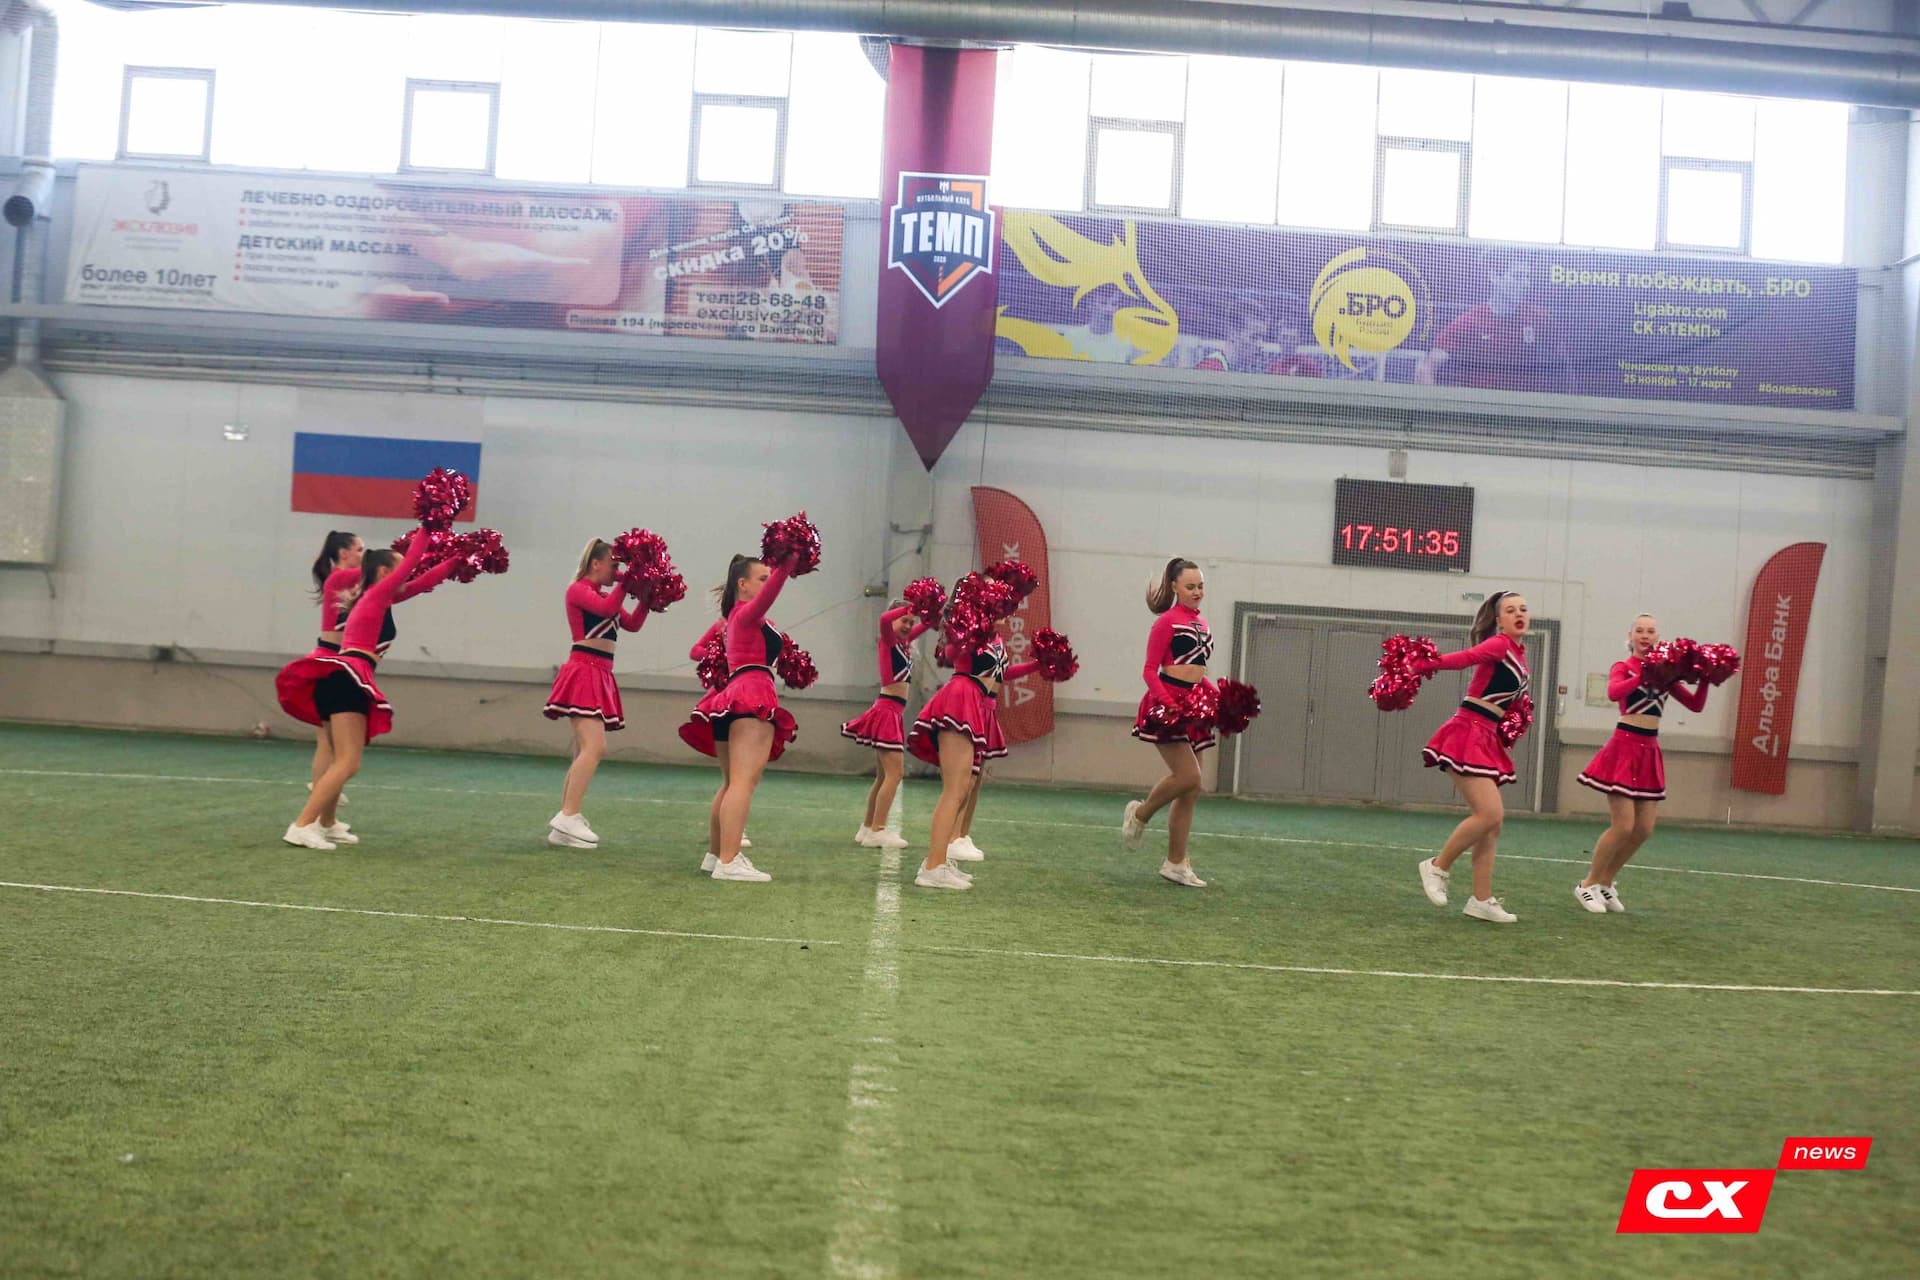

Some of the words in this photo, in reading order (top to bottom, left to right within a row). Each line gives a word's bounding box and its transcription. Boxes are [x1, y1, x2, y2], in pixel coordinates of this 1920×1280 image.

[238, 233, 325, 252] ДЕТСКИЙ
[901, 211, 984, 259] ТЕМП
[653, 245, 746, 280] скидка
[750, 224, 809, 256] 20%
[81, 265, 148, 284] более
[155, 269, 217, 288] 10лет
[1551, 265, 1620, 287] Время
[1626, 271, 1751, 297] побеждать,
[1760, 277, 1811, 298] .БРО
[696, 308, 825, 326] exclusive22.ru
[1338, 292, 1408, 320] .БРО
[1633, 301, 1728, 321] Ligabro.com
[621, 317, 645, 328] 194
[1633, 319, 1654, 335] СК
[1658, 321, 1721, 337] «ТЕМП»
[1623, 374, 1637, 384] 25
[1687, 377, 1698, 387] 17
[1341, 524, 1460, 556] 17:51:35
[1765, 594, 1792, 661] Банк
[1752, 667, 1782, 756] Альфа
